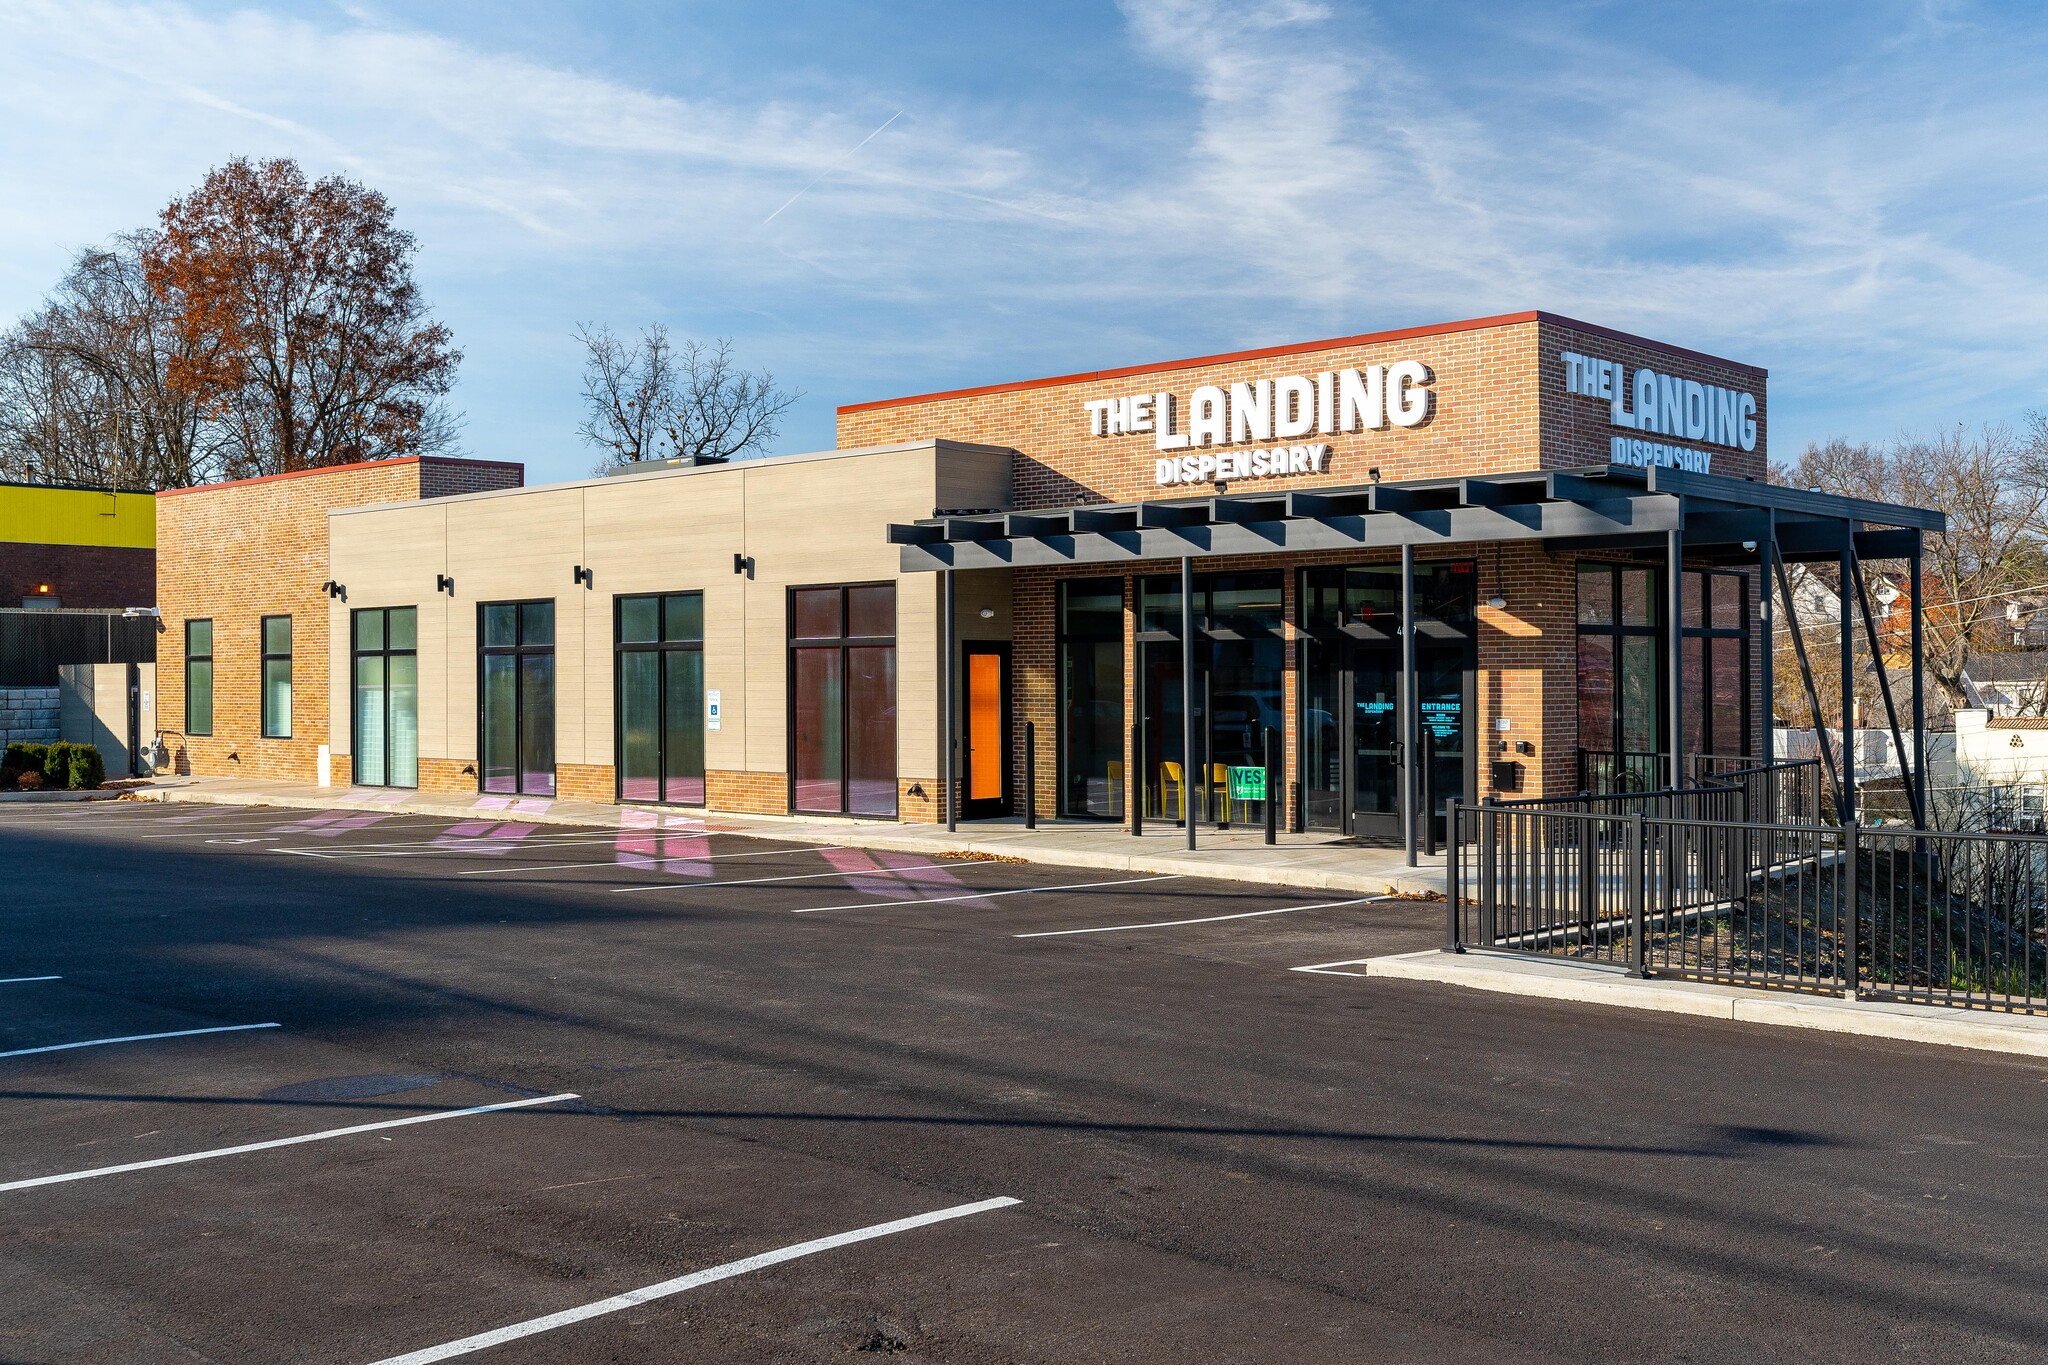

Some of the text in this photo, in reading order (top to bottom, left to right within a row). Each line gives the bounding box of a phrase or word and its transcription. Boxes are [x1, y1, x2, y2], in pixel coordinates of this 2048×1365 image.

[1084, 360, 1434, 450] THE LANDING
[1560, 351, 1757, 451] THE LANDING
[1156, 444, 1327, 486] DISPENSARY
[1611, 436, 1712, 474] DISPENSARY
[1234, 770, 1263, 785] YES
